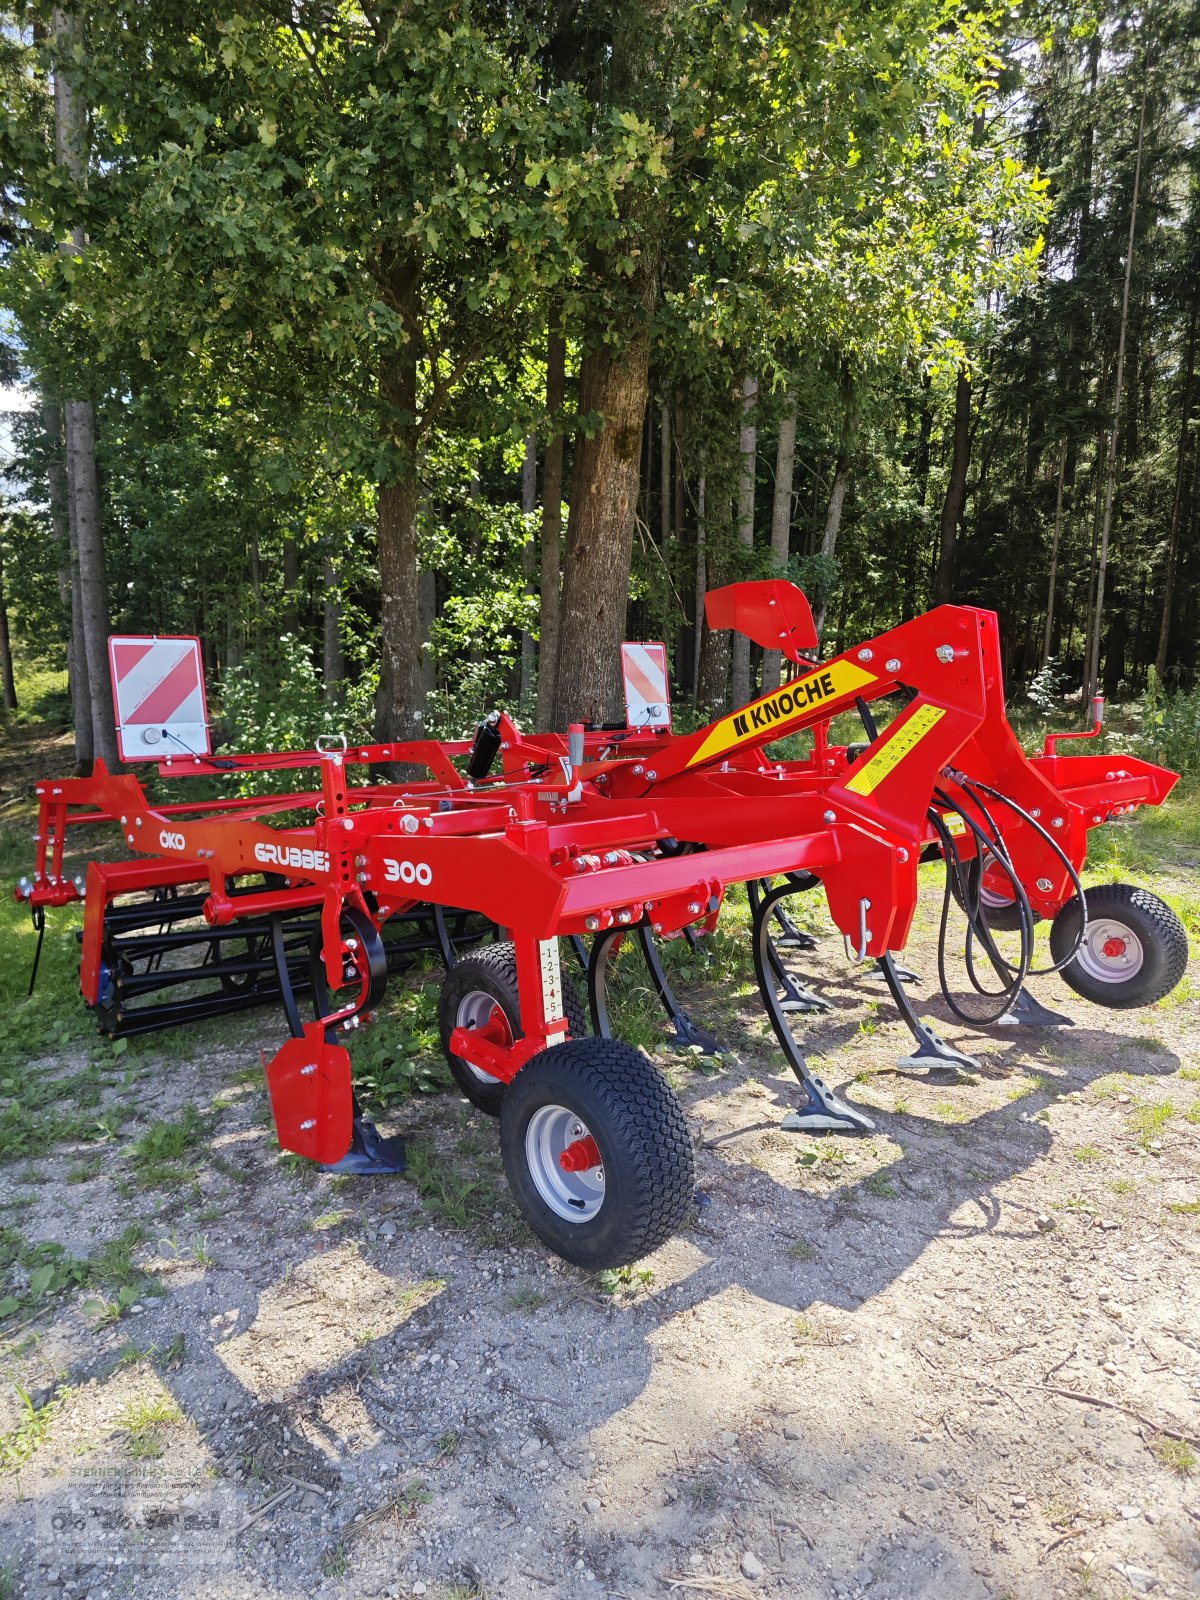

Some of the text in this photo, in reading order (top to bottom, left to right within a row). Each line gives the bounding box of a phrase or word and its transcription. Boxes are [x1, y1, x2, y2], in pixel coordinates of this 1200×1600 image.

[751, 672, 835, 730] KNOCHE
[159, 830, 186, 851] ÖKO
[383, 858, 433, 886] 300
[546, 948, 552, 957] 1
[547, 962, 553, 972] 2
[548, 975, 554, 985] 3
[549, 988, 555, 998] 4
[550, 1002, 556, 1012] 5
